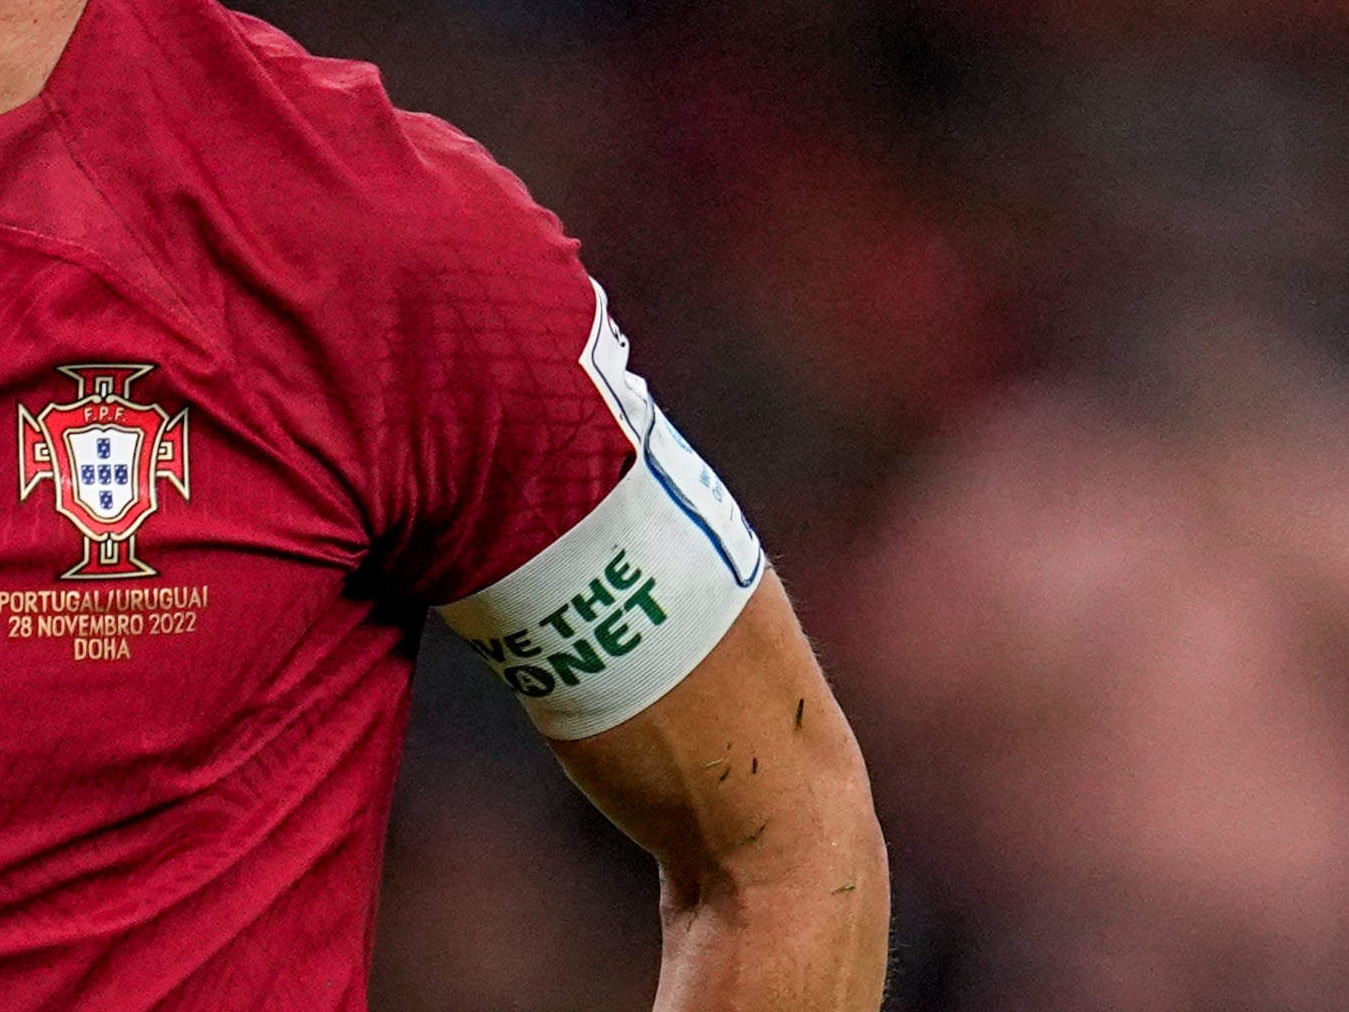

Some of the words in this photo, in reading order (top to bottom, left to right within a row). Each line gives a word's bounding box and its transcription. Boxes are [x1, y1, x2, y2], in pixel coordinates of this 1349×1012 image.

[83, 406, 126, 423] F.P.F.
[538, 548, 643, 639] THE
[8, 615, 32, 638] 28
[37, 613, 144, 638] NOVEMBRO
[149, 611, 197, 636] 2022
[73, 638, 131, 661] DOHA
